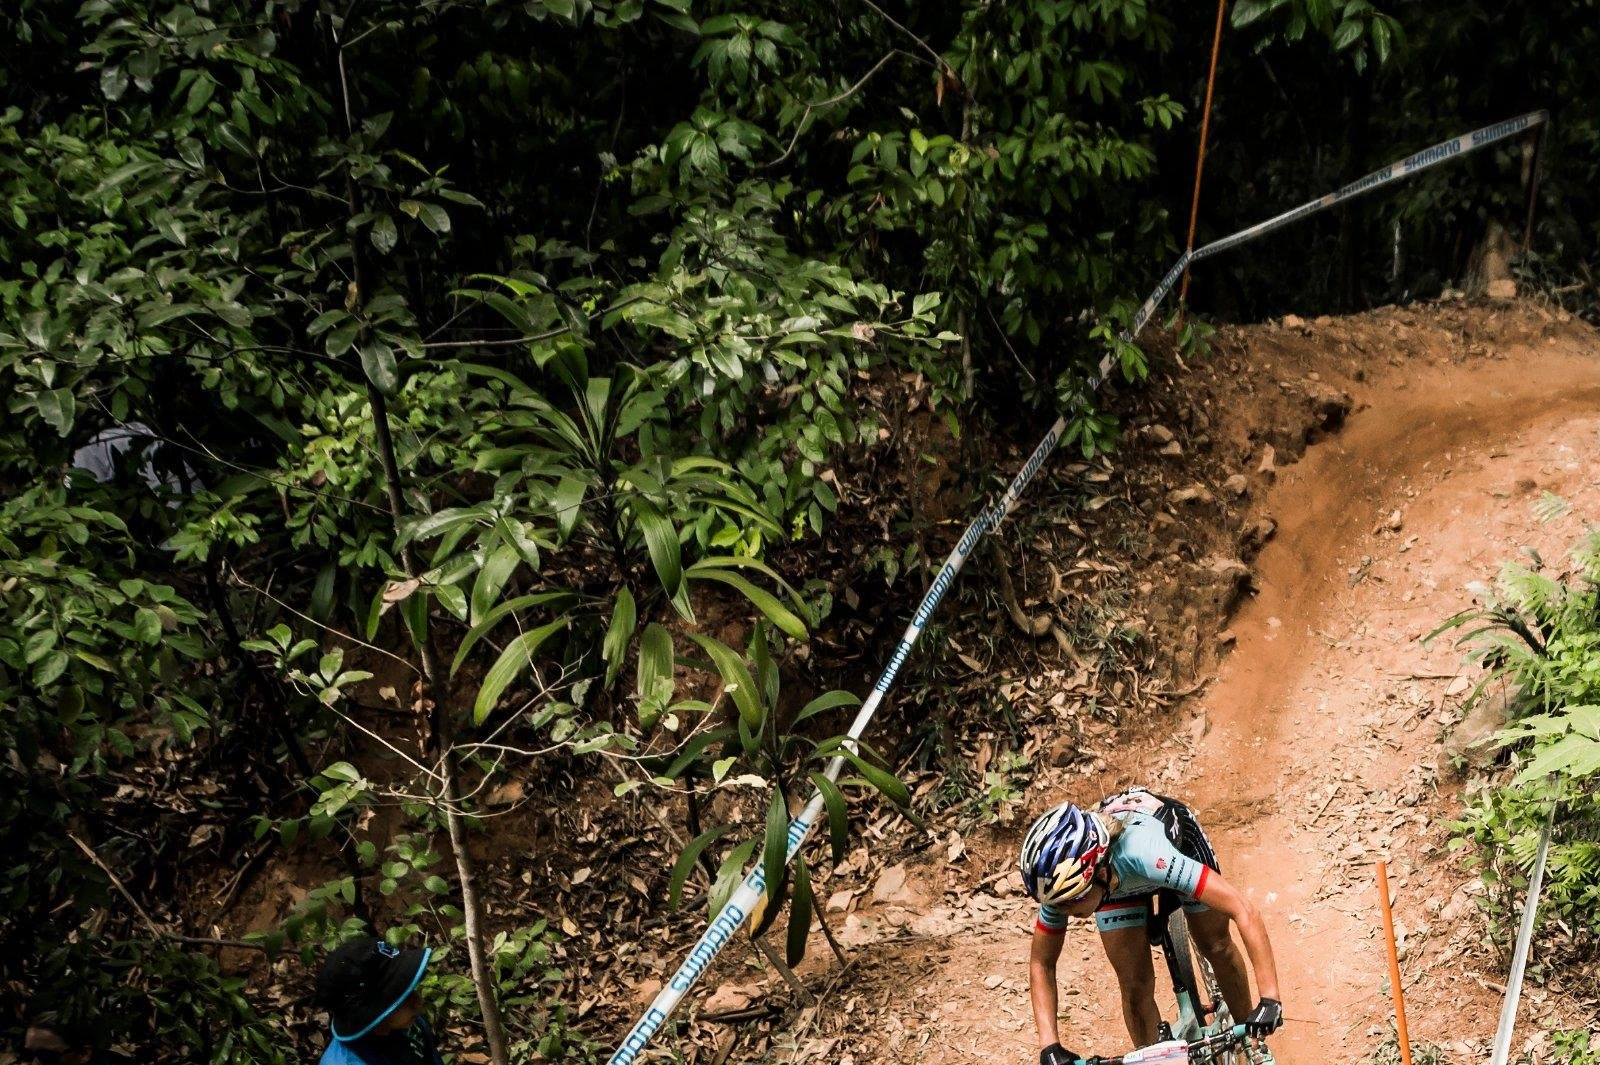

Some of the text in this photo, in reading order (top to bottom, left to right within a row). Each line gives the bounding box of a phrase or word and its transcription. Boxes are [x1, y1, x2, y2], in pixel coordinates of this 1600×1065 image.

[1404, 138, 1461, 172] SHIMANO
[1013, 430, 1056, 494] SHIMANO
[671, 904, 744, 992] SHIMANO
